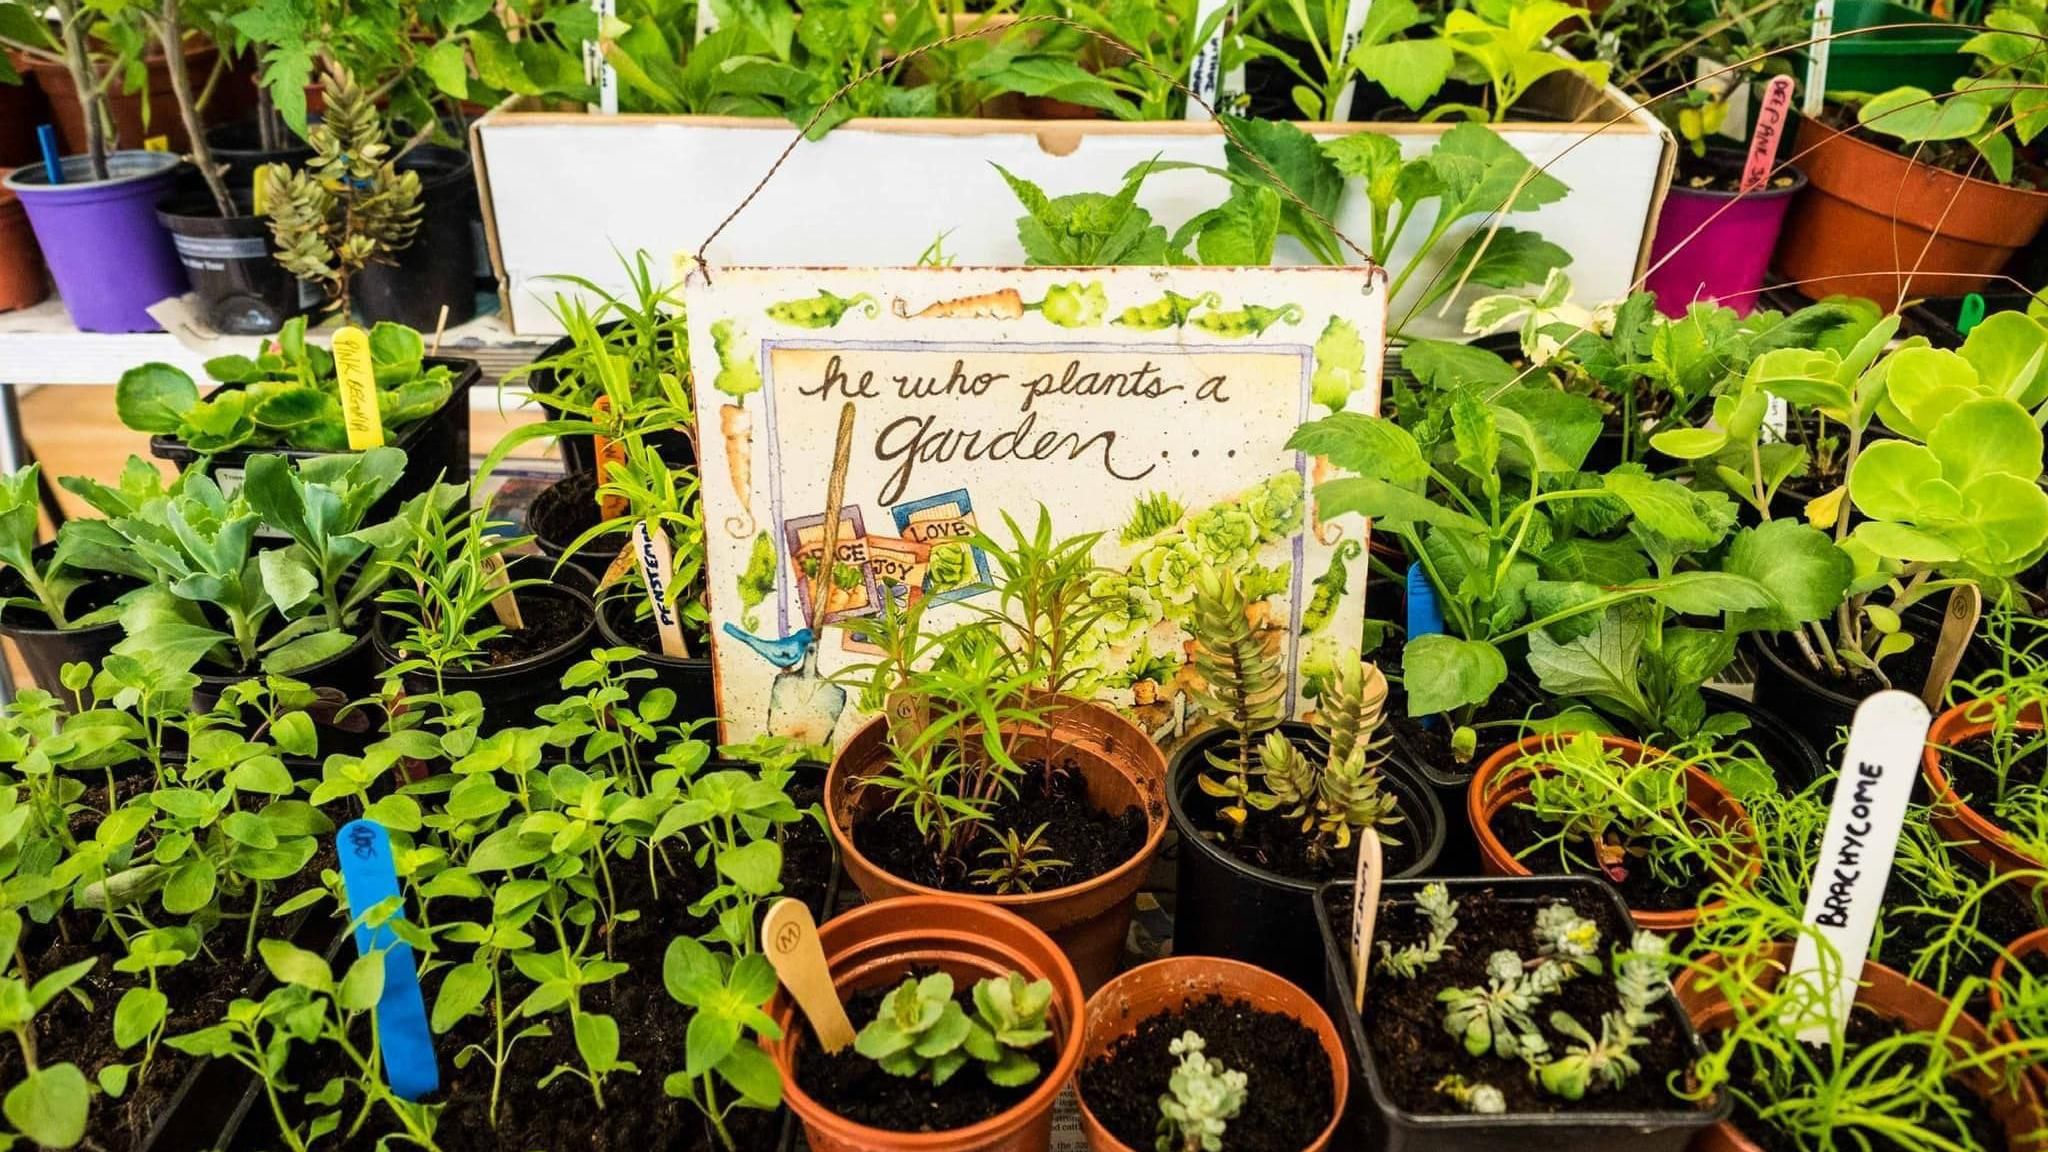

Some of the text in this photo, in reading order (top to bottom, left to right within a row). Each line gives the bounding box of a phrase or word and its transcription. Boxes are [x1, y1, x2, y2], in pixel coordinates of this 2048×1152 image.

[335, 340, 361, 374] PINK
[799, 355, 1231, 411] he who plants a
[910, 522, 971, 543] LOVE
[873, 559, 915, 581] JOY
[1815, 762, 1884, 929] BRACHYCOME
